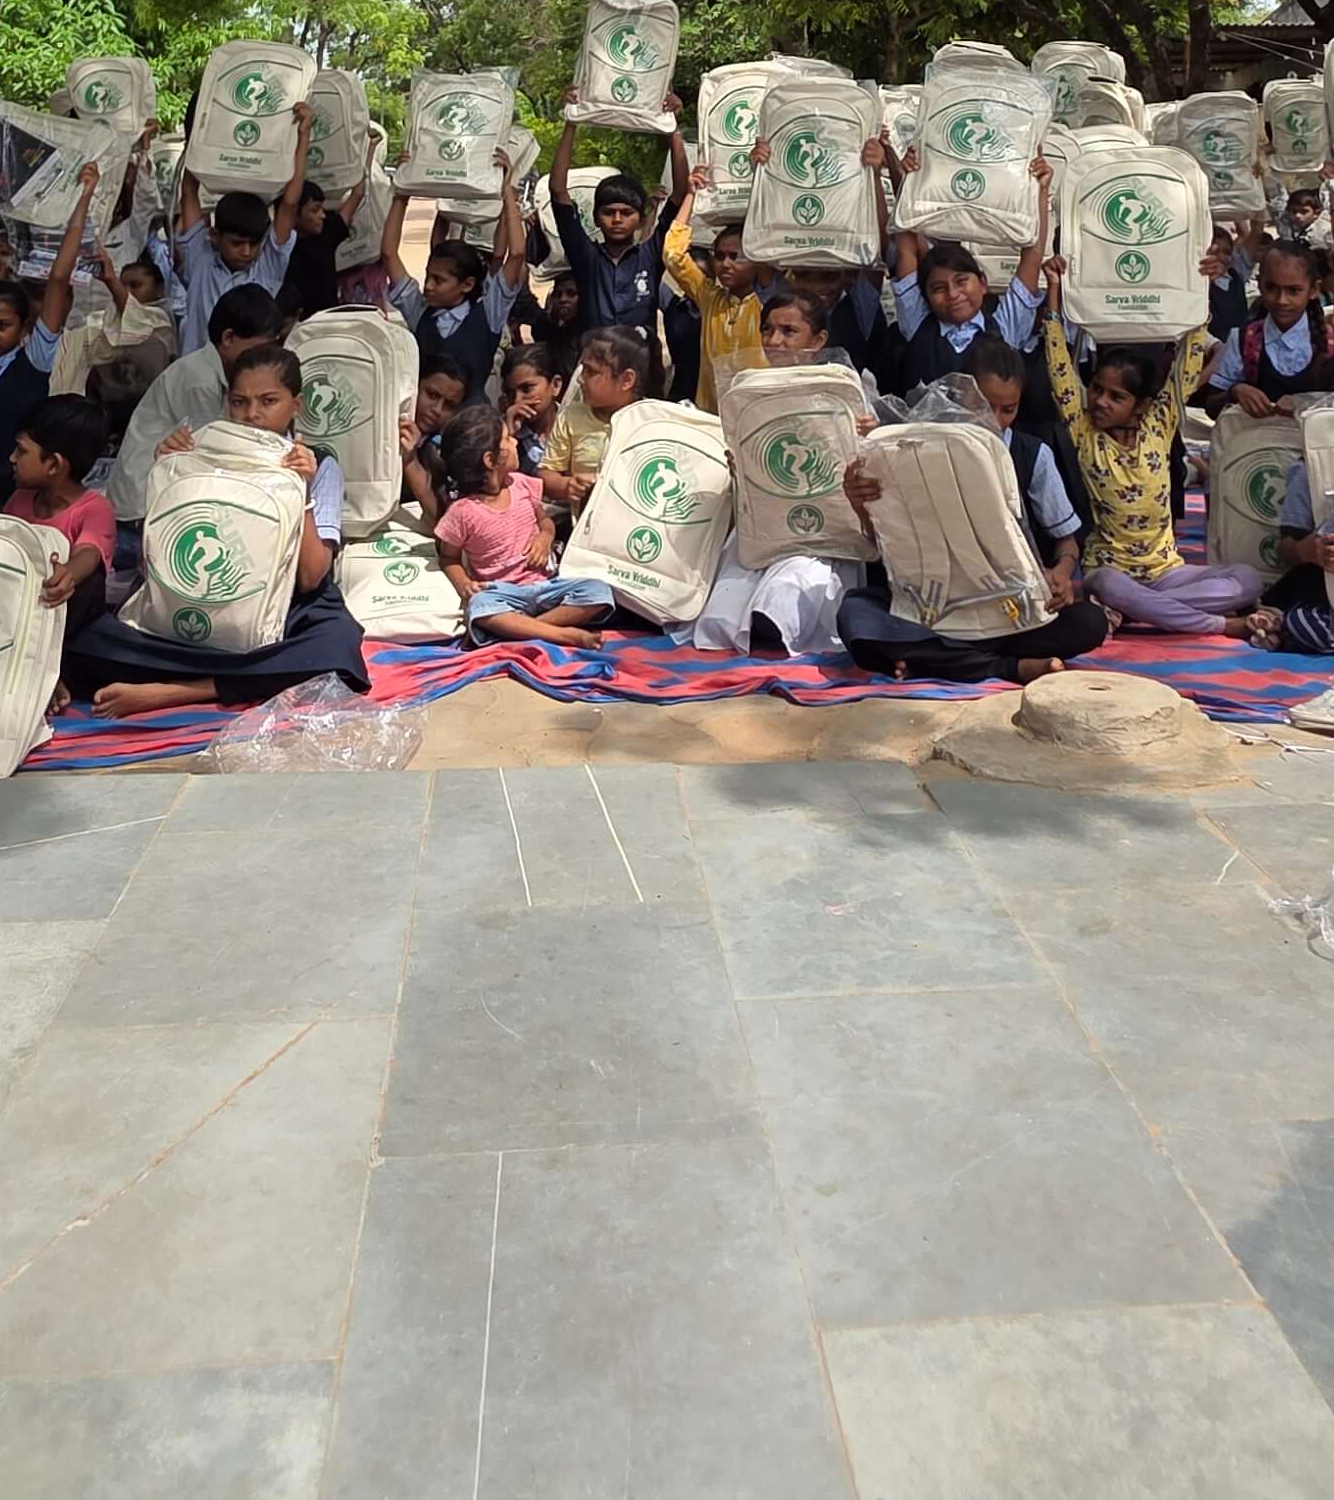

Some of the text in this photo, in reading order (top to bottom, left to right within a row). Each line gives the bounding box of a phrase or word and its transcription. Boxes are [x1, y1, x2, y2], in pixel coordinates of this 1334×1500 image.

[1105, 294, 1161, 304] Sarva Vriddhi
[607, 564, 661, 588] Sarva Vriddhi
